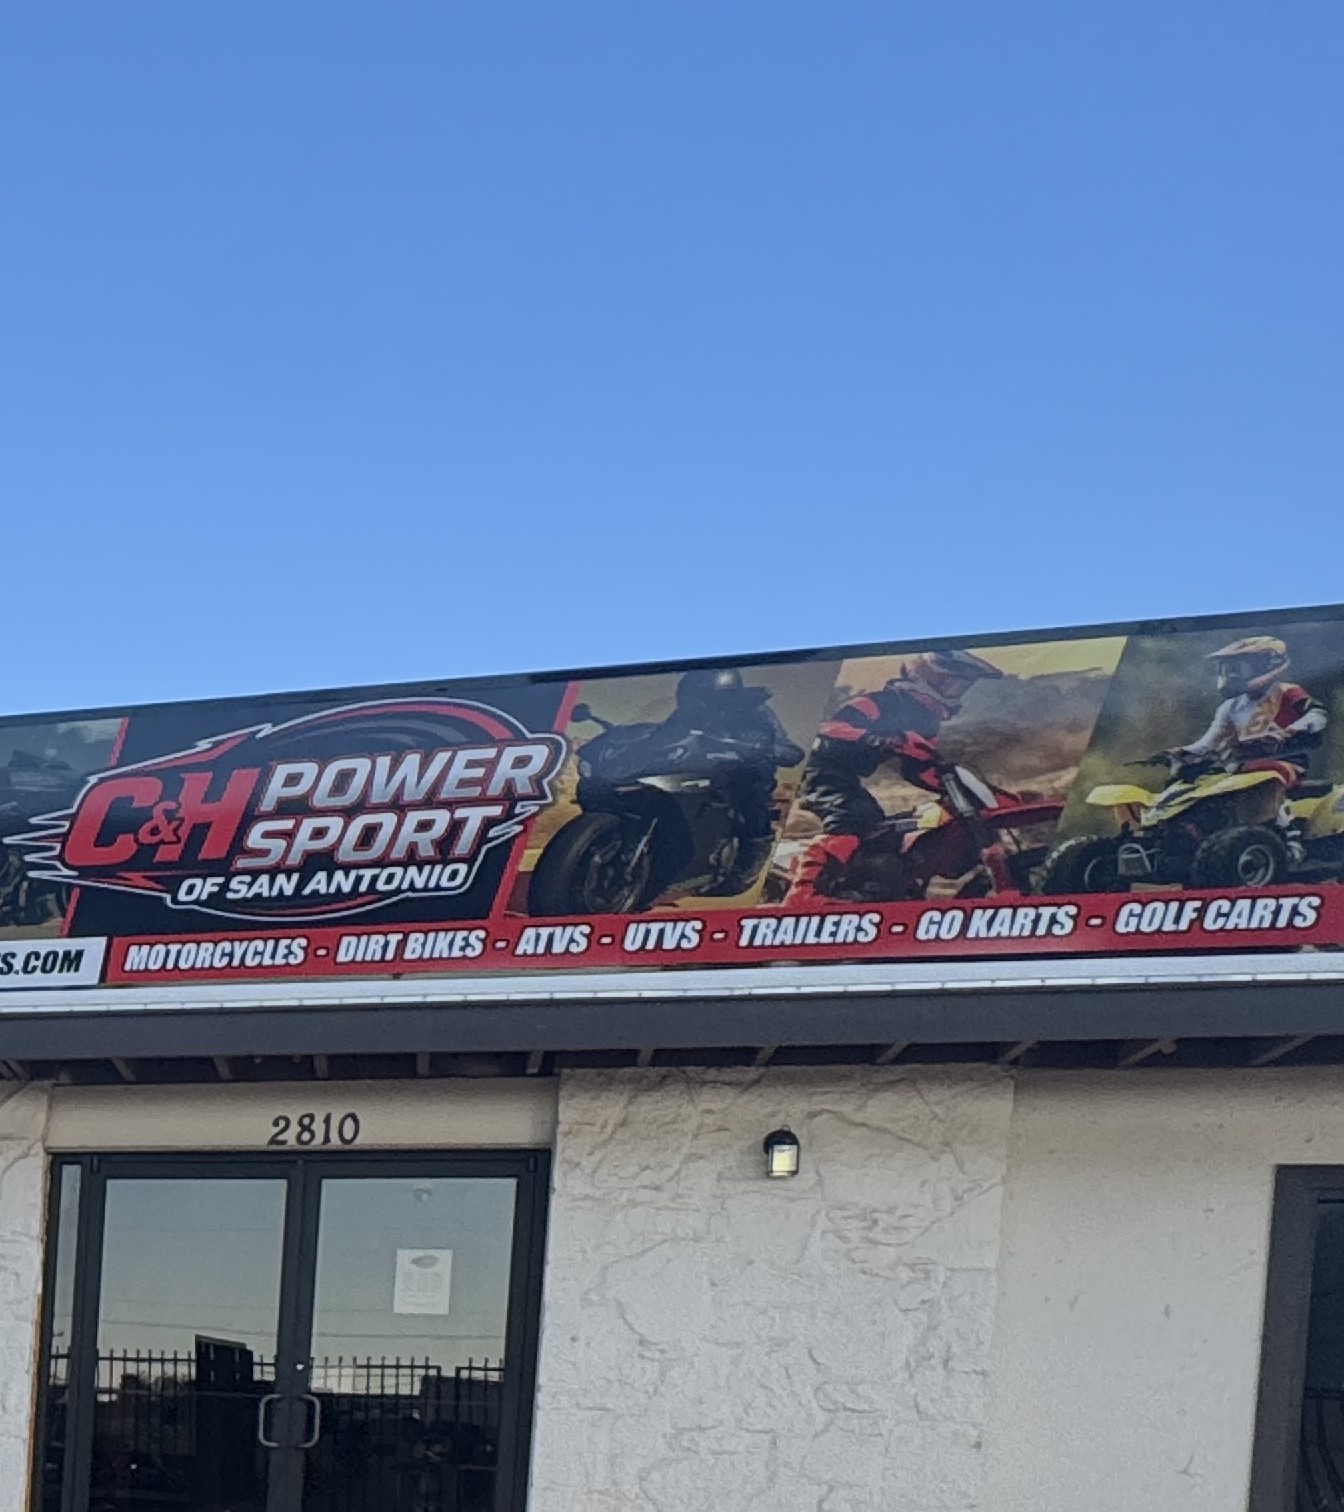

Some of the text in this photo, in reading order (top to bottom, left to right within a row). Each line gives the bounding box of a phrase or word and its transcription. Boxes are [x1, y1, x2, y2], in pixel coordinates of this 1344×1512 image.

[258, 743, 551, 813] POWER
[63, 768, 260, 867] C&H
[234, 805, 506, 870] SPORT
[176, 863, 470, 903] OF SAN ANTONIO
[123, 896, 1320, 971] MOTORCYCLES DIRT BIKES ATVS UTVS TRAILERS GO KARTS GOLF CARTS
[267, 1112, 360, 1146] 2810
